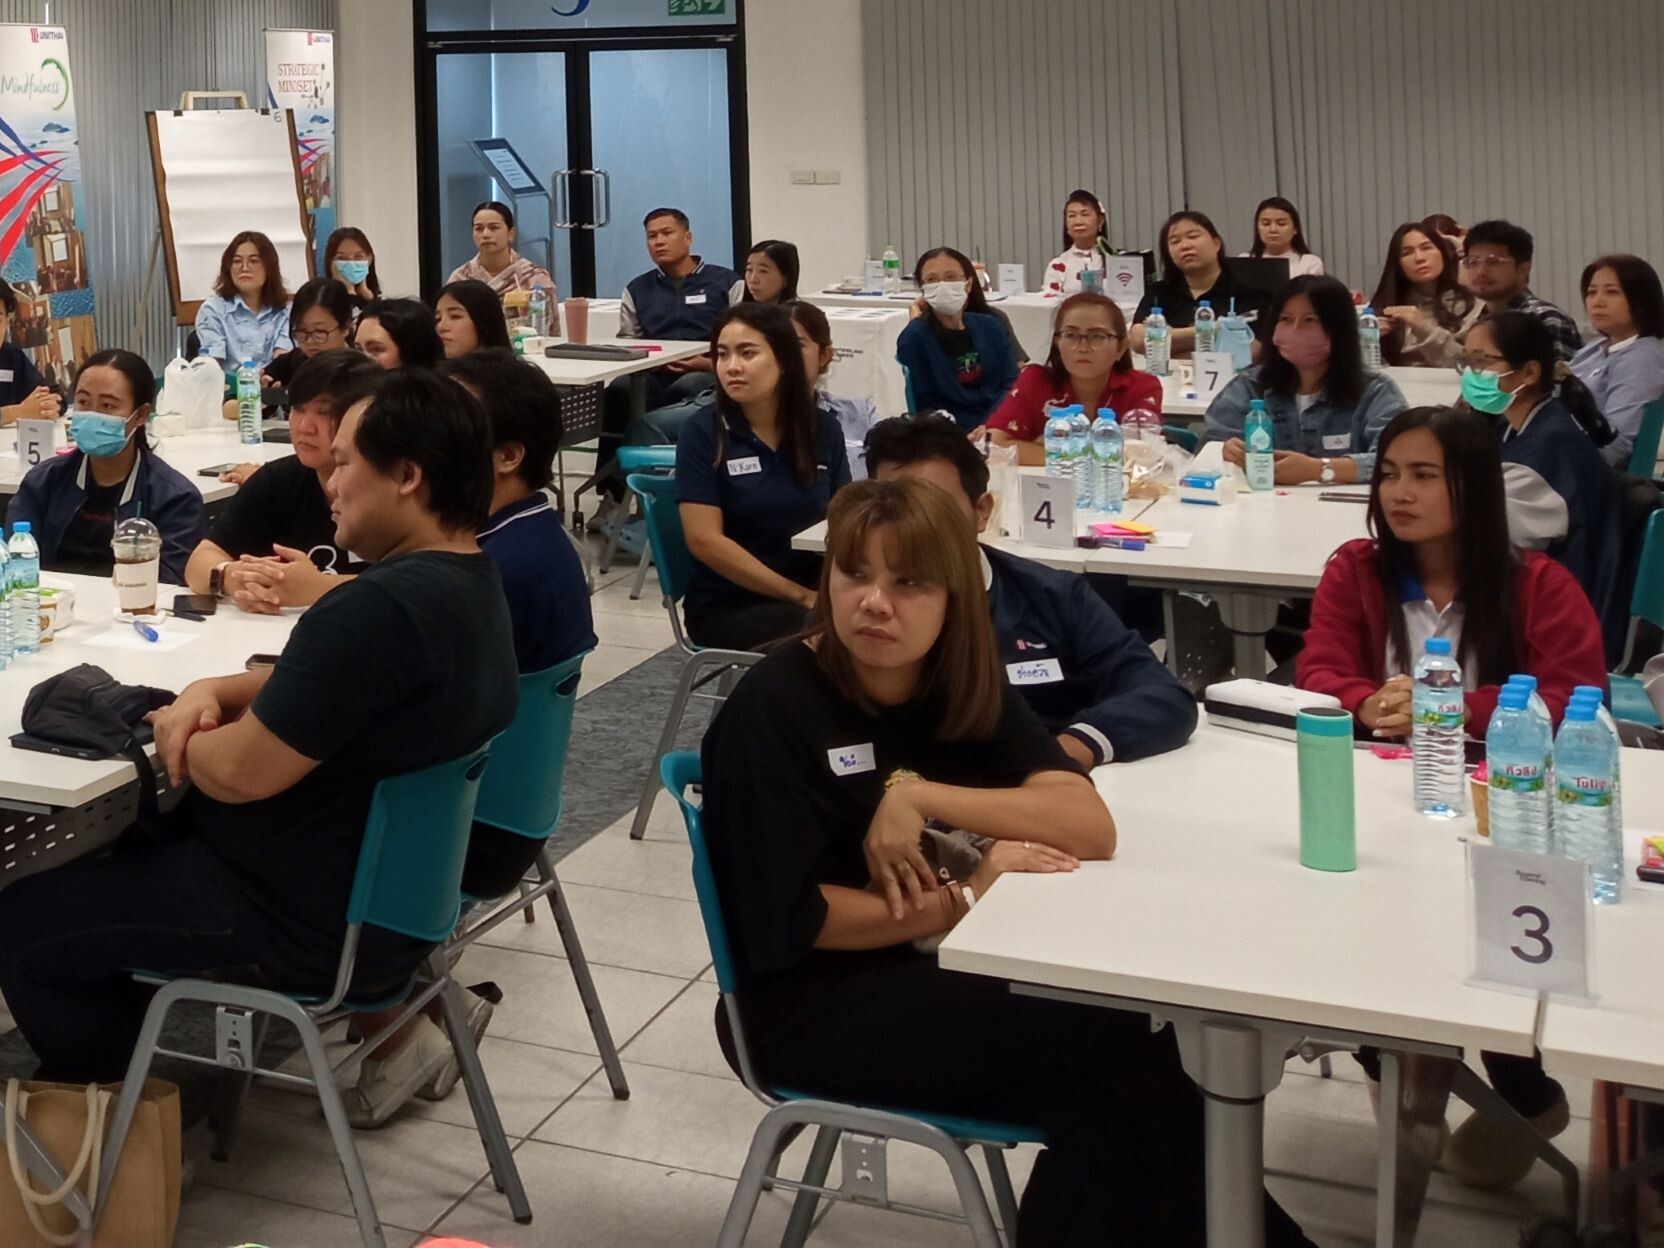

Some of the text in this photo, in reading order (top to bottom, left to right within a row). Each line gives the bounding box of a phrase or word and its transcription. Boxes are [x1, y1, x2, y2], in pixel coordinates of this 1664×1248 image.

[1205, 371, 1218, 391] 7
[28, 441, 40, 466] 5
[1034, 501, 1055, 529] 4
[1572, 776, 1607, 791] Tulip
[1510, 905, 1553, 964] 3
